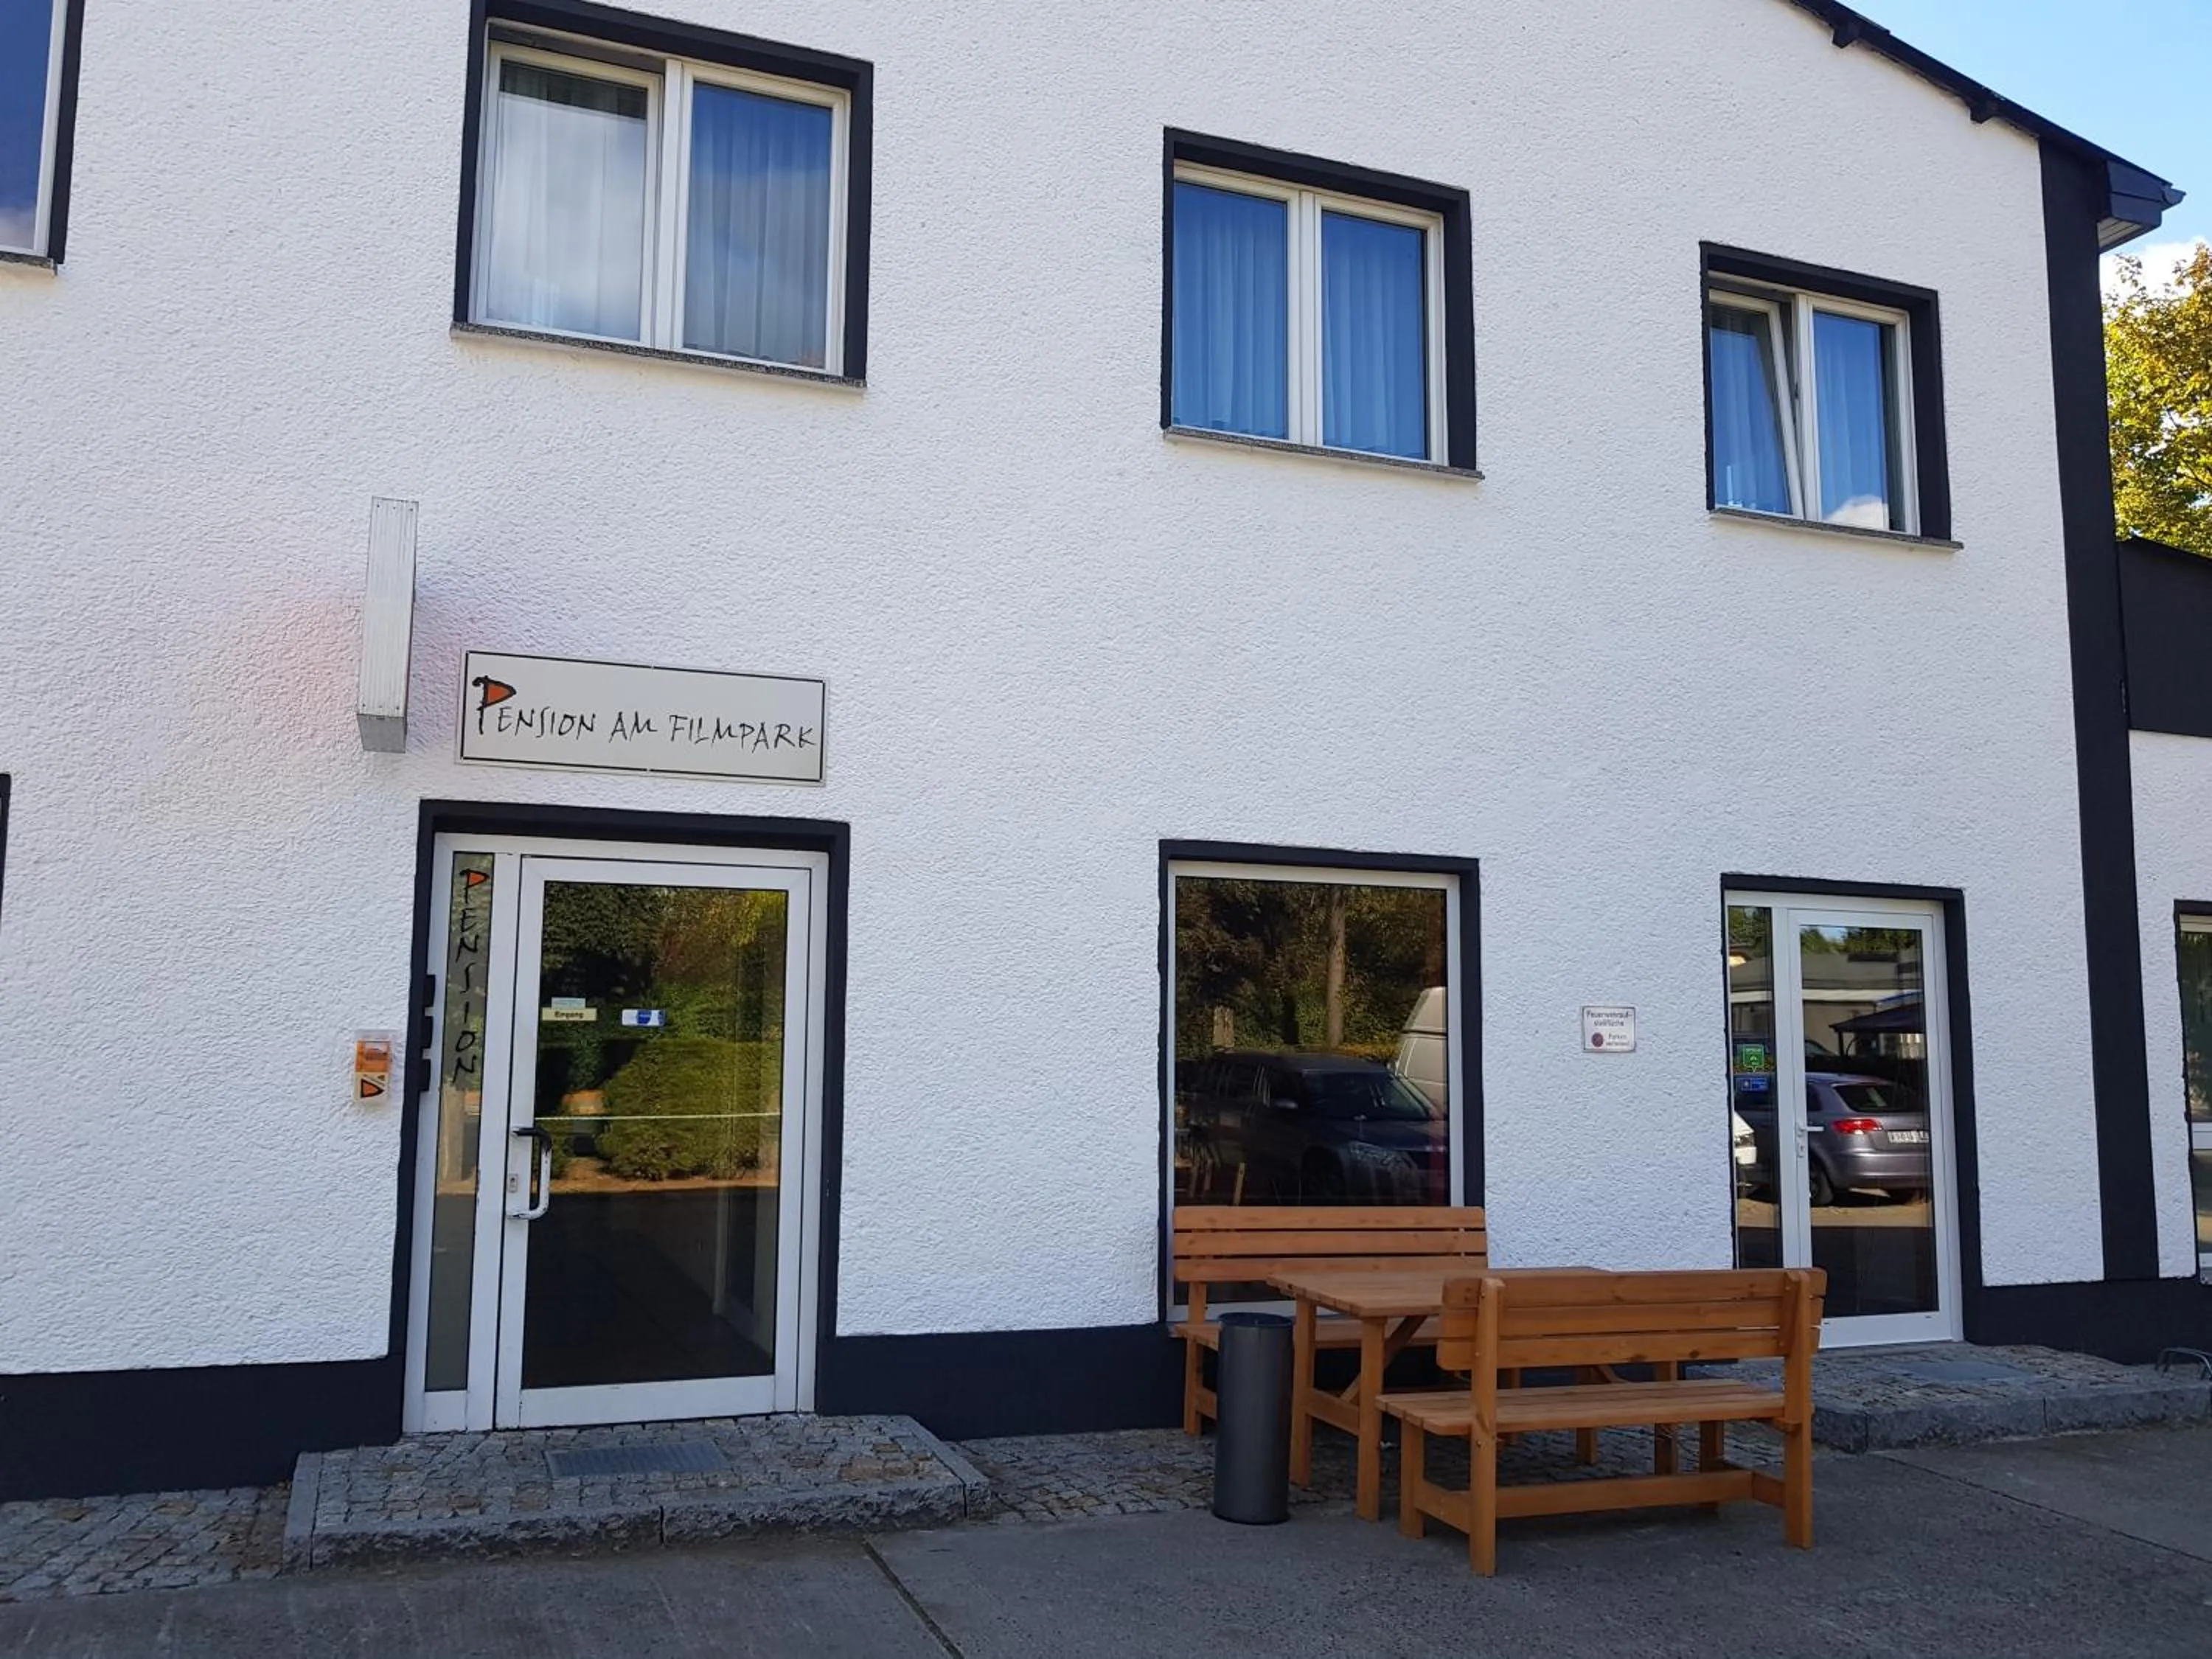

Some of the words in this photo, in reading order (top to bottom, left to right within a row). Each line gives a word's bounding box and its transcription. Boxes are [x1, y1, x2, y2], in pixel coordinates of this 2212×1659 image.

[471, 675, 597, 740] PENSION
[608, 711, 658, 743] AM
[669, 714, 817, 754] FILMPARK
[452, 868, 490, 1083] PENSION
[554, 1011, 584, 1020] Eingang
